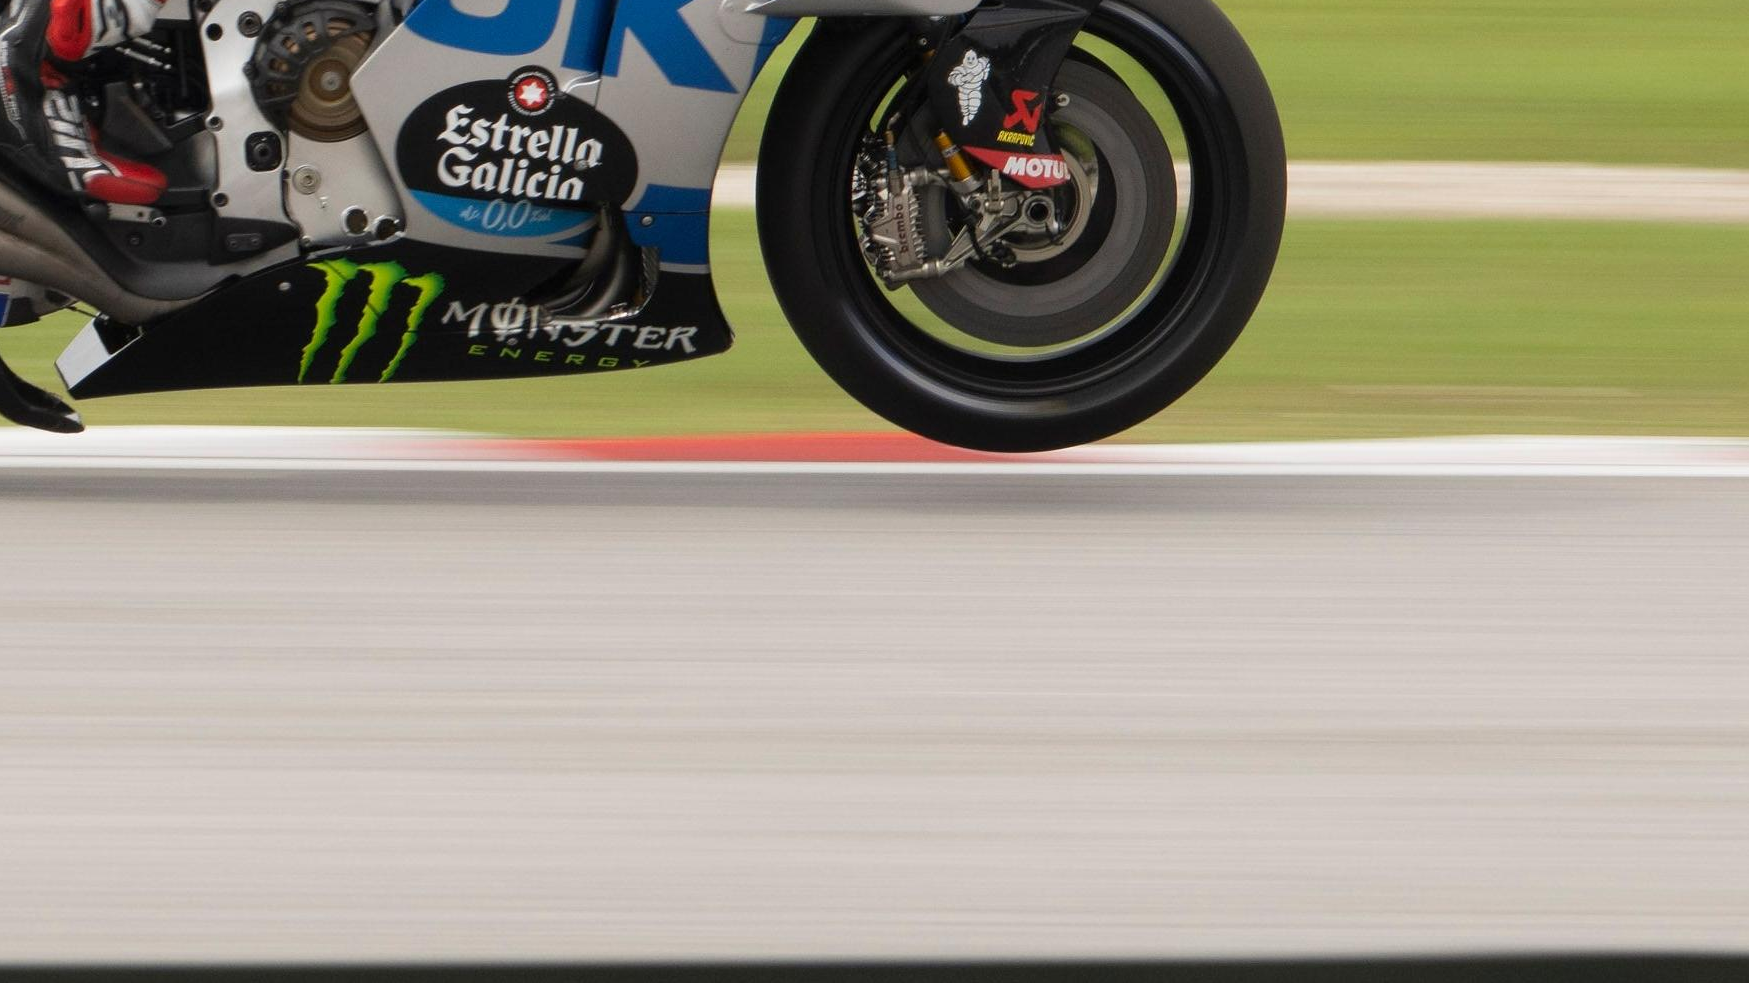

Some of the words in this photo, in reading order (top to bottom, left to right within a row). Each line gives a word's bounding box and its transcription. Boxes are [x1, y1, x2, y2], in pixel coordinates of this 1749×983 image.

[436, 103, 603, 170] Estrella
[437, 146, 585, 200] Galicia
[895, 203, 909, 255] brembo
[441, 296, 698, 354] MONSTER
[467, 344, 651, 369] ENERGY
